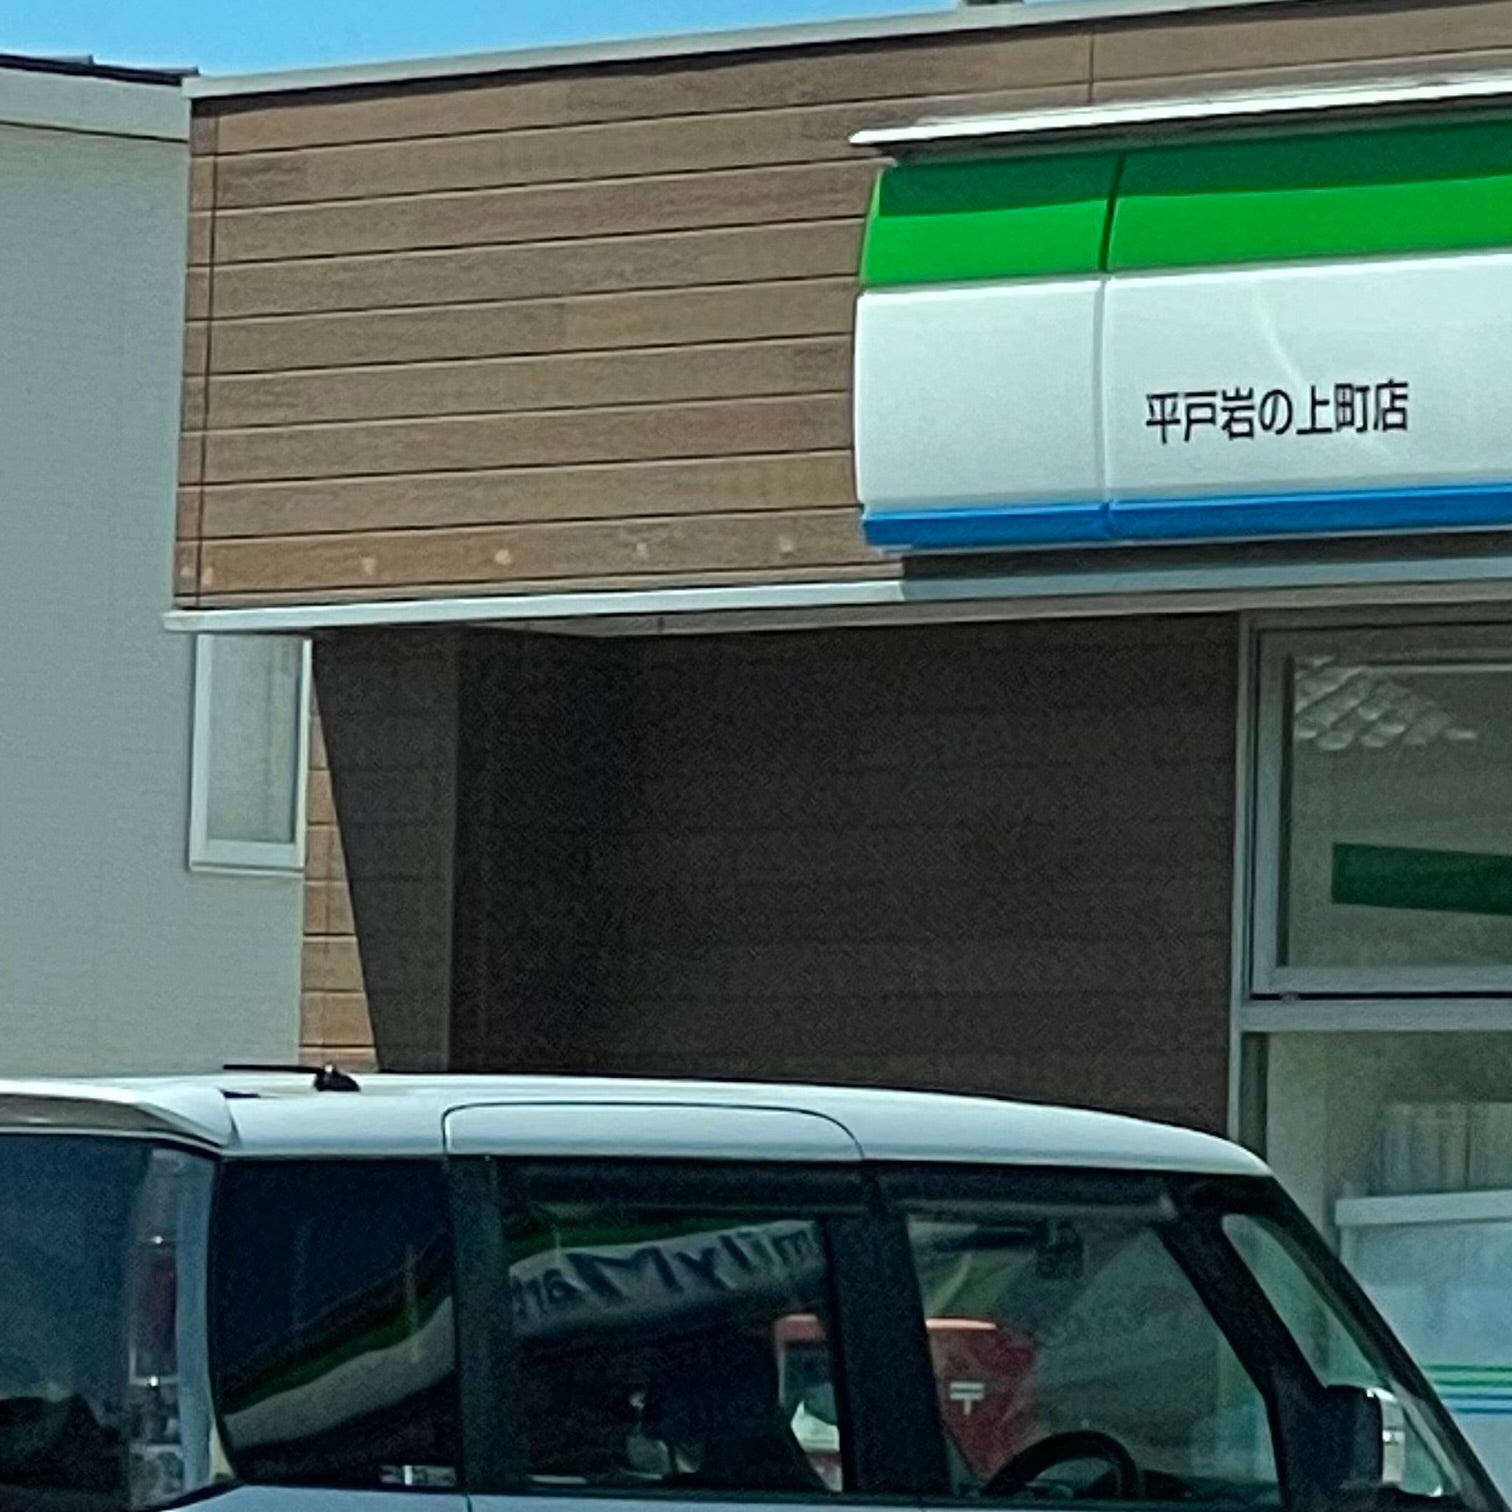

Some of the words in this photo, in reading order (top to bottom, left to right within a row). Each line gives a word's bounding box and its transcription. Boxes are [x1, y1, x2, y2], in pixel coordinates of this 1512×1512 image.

[1146, 379, 1408, 444] 平戸岩の上町店
